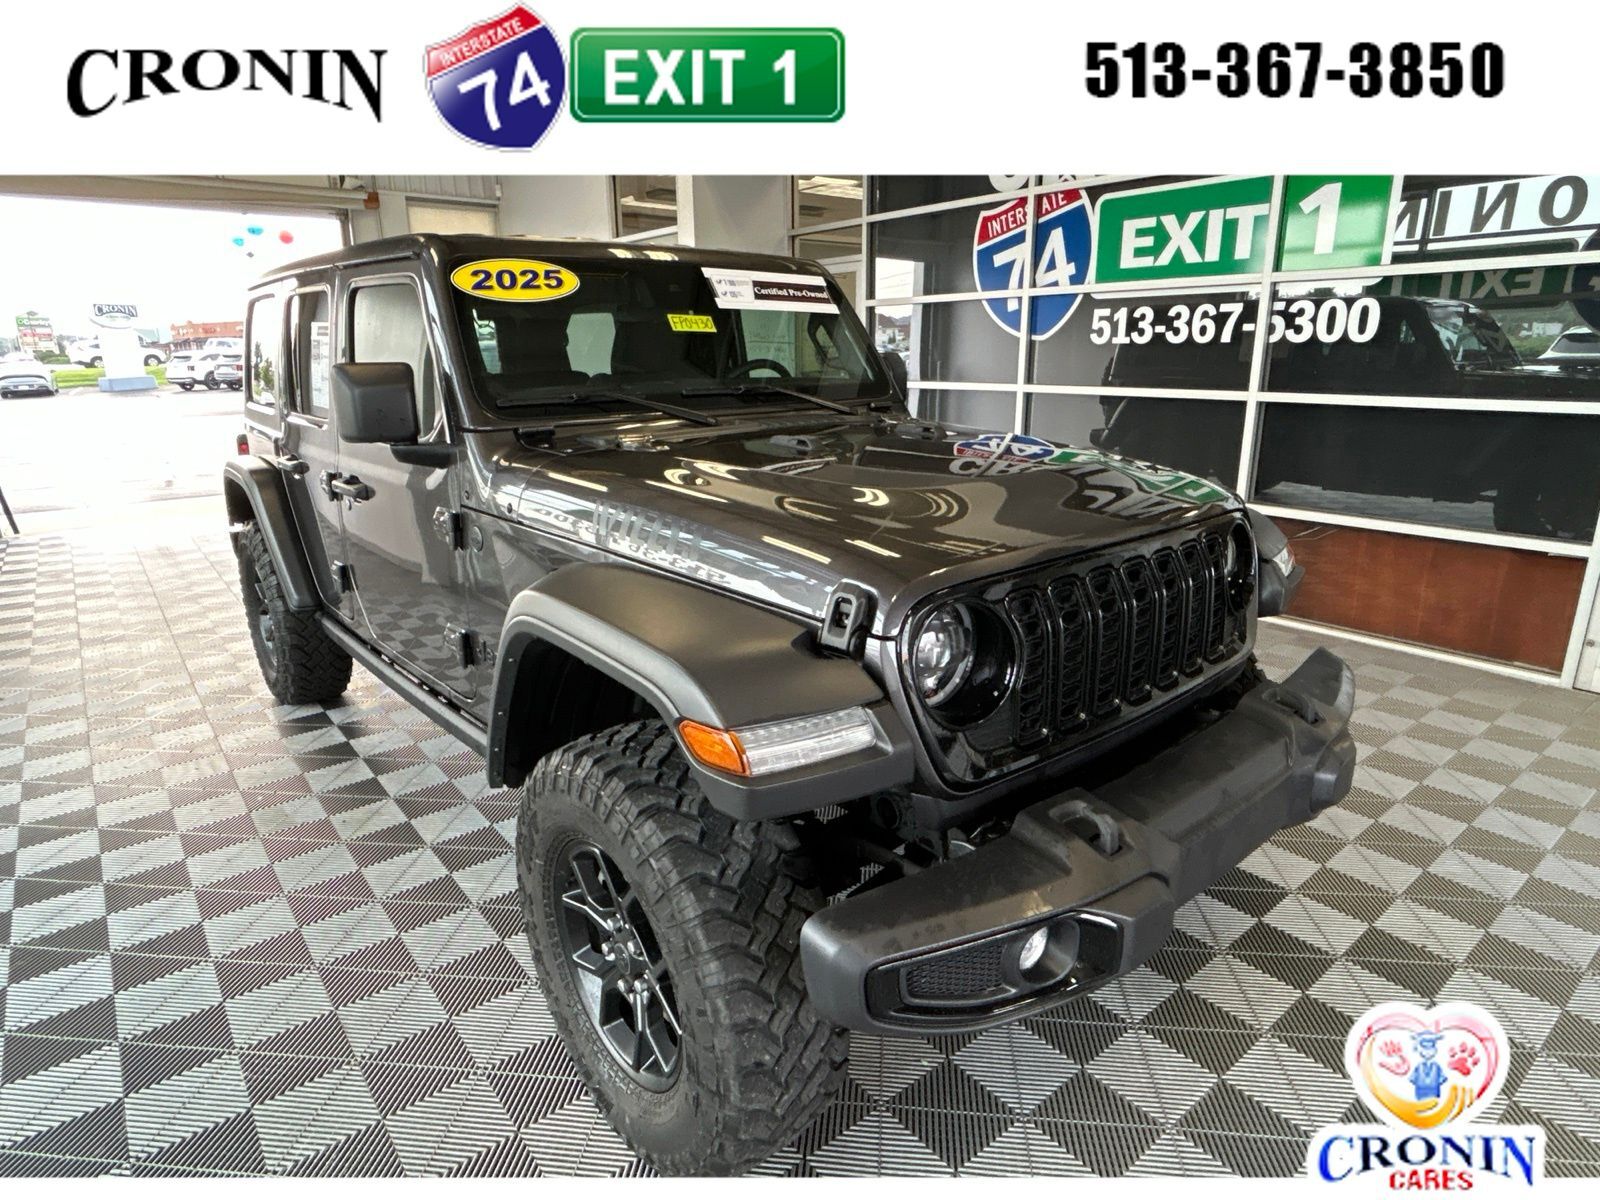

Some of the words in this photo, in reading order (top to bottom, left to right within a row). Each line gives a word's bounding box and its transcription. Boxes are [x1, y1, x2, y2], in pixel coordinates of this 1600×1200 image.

[988, 192, 1068, 239] INTERATE
[1119, 203, 1270, 269] EXIT
[1298, 182, 1343, 255] 1
[470, 268, 564, 291] 2025
[754, 286, 788, 297] Certified
[789, 288, 829, 299] Pre-Owned
[993, 227, 1076, 313] 74
[94, 304, 137, 317] CRONIN
[1090, 298, 1381, 344] 513-367-5300
